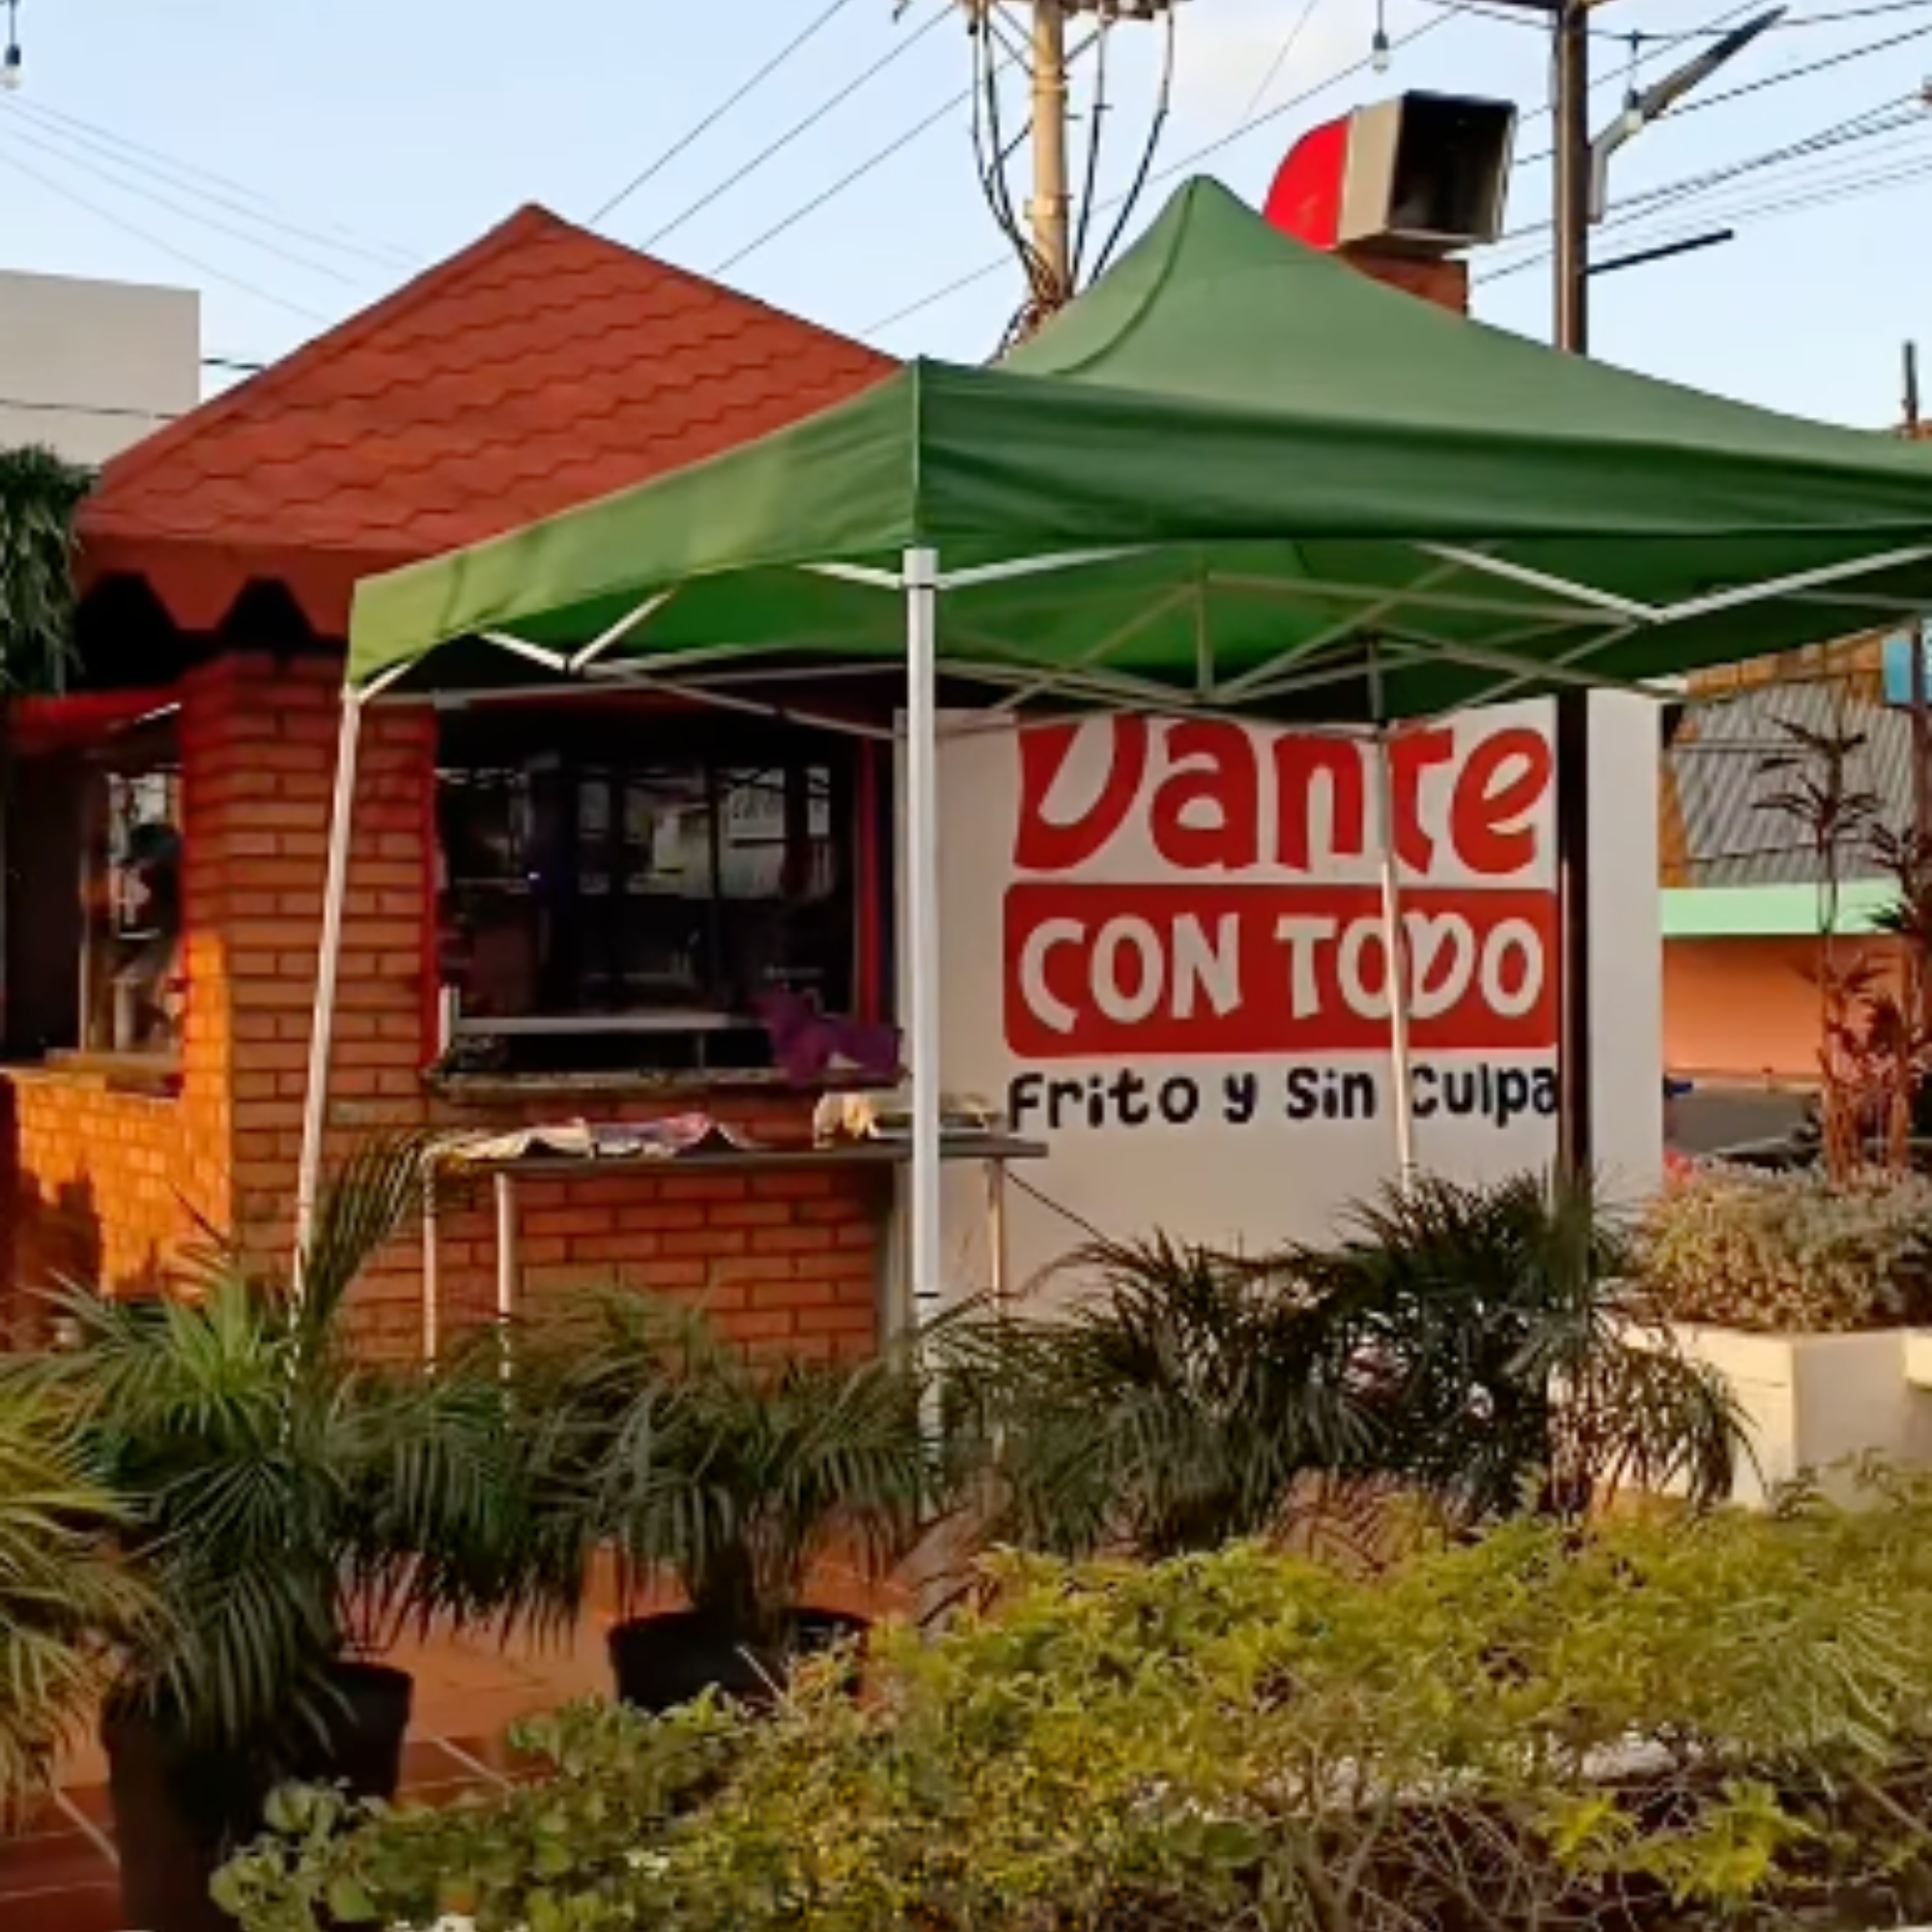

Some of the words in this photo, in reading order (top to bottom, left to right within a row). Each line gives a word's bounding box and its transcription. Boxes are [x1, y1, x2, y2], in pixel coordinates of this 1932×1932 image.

[1013, 713, 1552, 875] Dante
[1019, 912, 1243, 1035] CON
[1273, 910, 1544, 1020] TODO
[1008, 1067, 1200, 1132] Frito
[1222, 1071, 1257, 1123] y
[1286, 1066, 1376, 1120] Sin
[1411, 1063, 1559, 1127] Culpa
